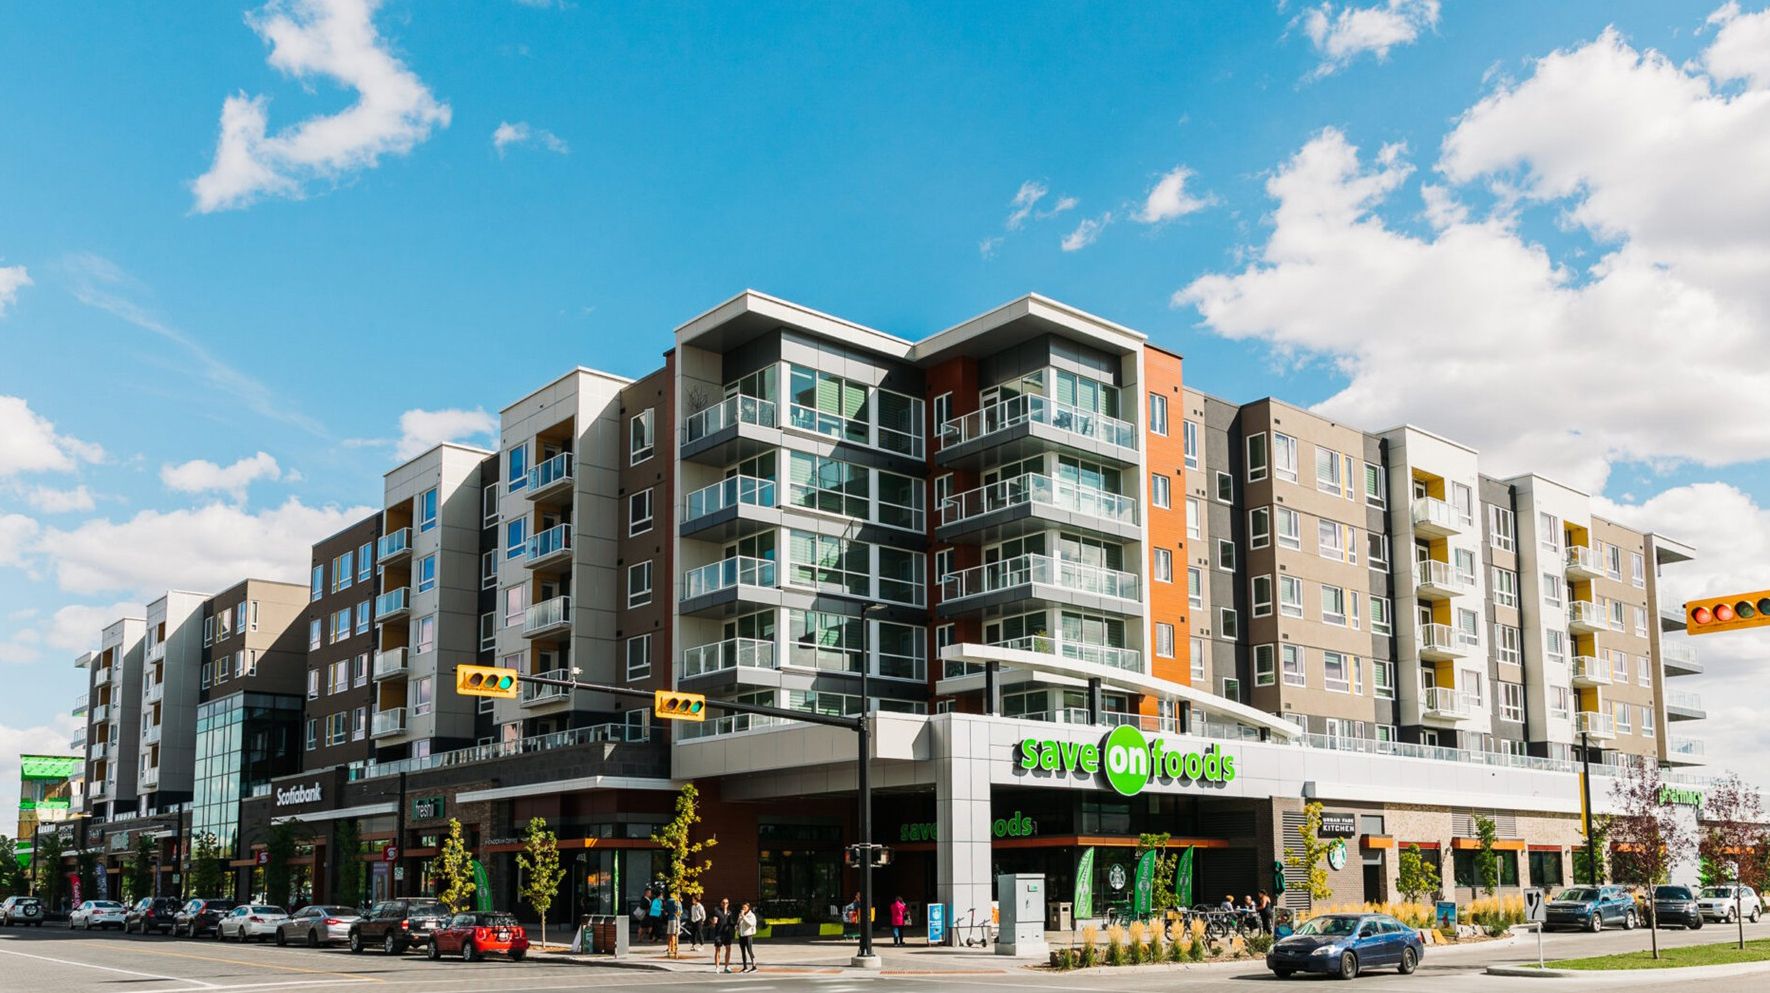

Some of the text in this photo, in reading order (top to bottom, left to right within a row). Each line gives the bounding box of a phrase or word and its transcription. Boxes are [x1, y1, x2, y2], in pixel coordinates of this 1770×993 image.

[1021, 738, 1236, 782] save on foods
[277, 782, 322, 806] Scotiabank
[989, 811, 1033, 837] ods
